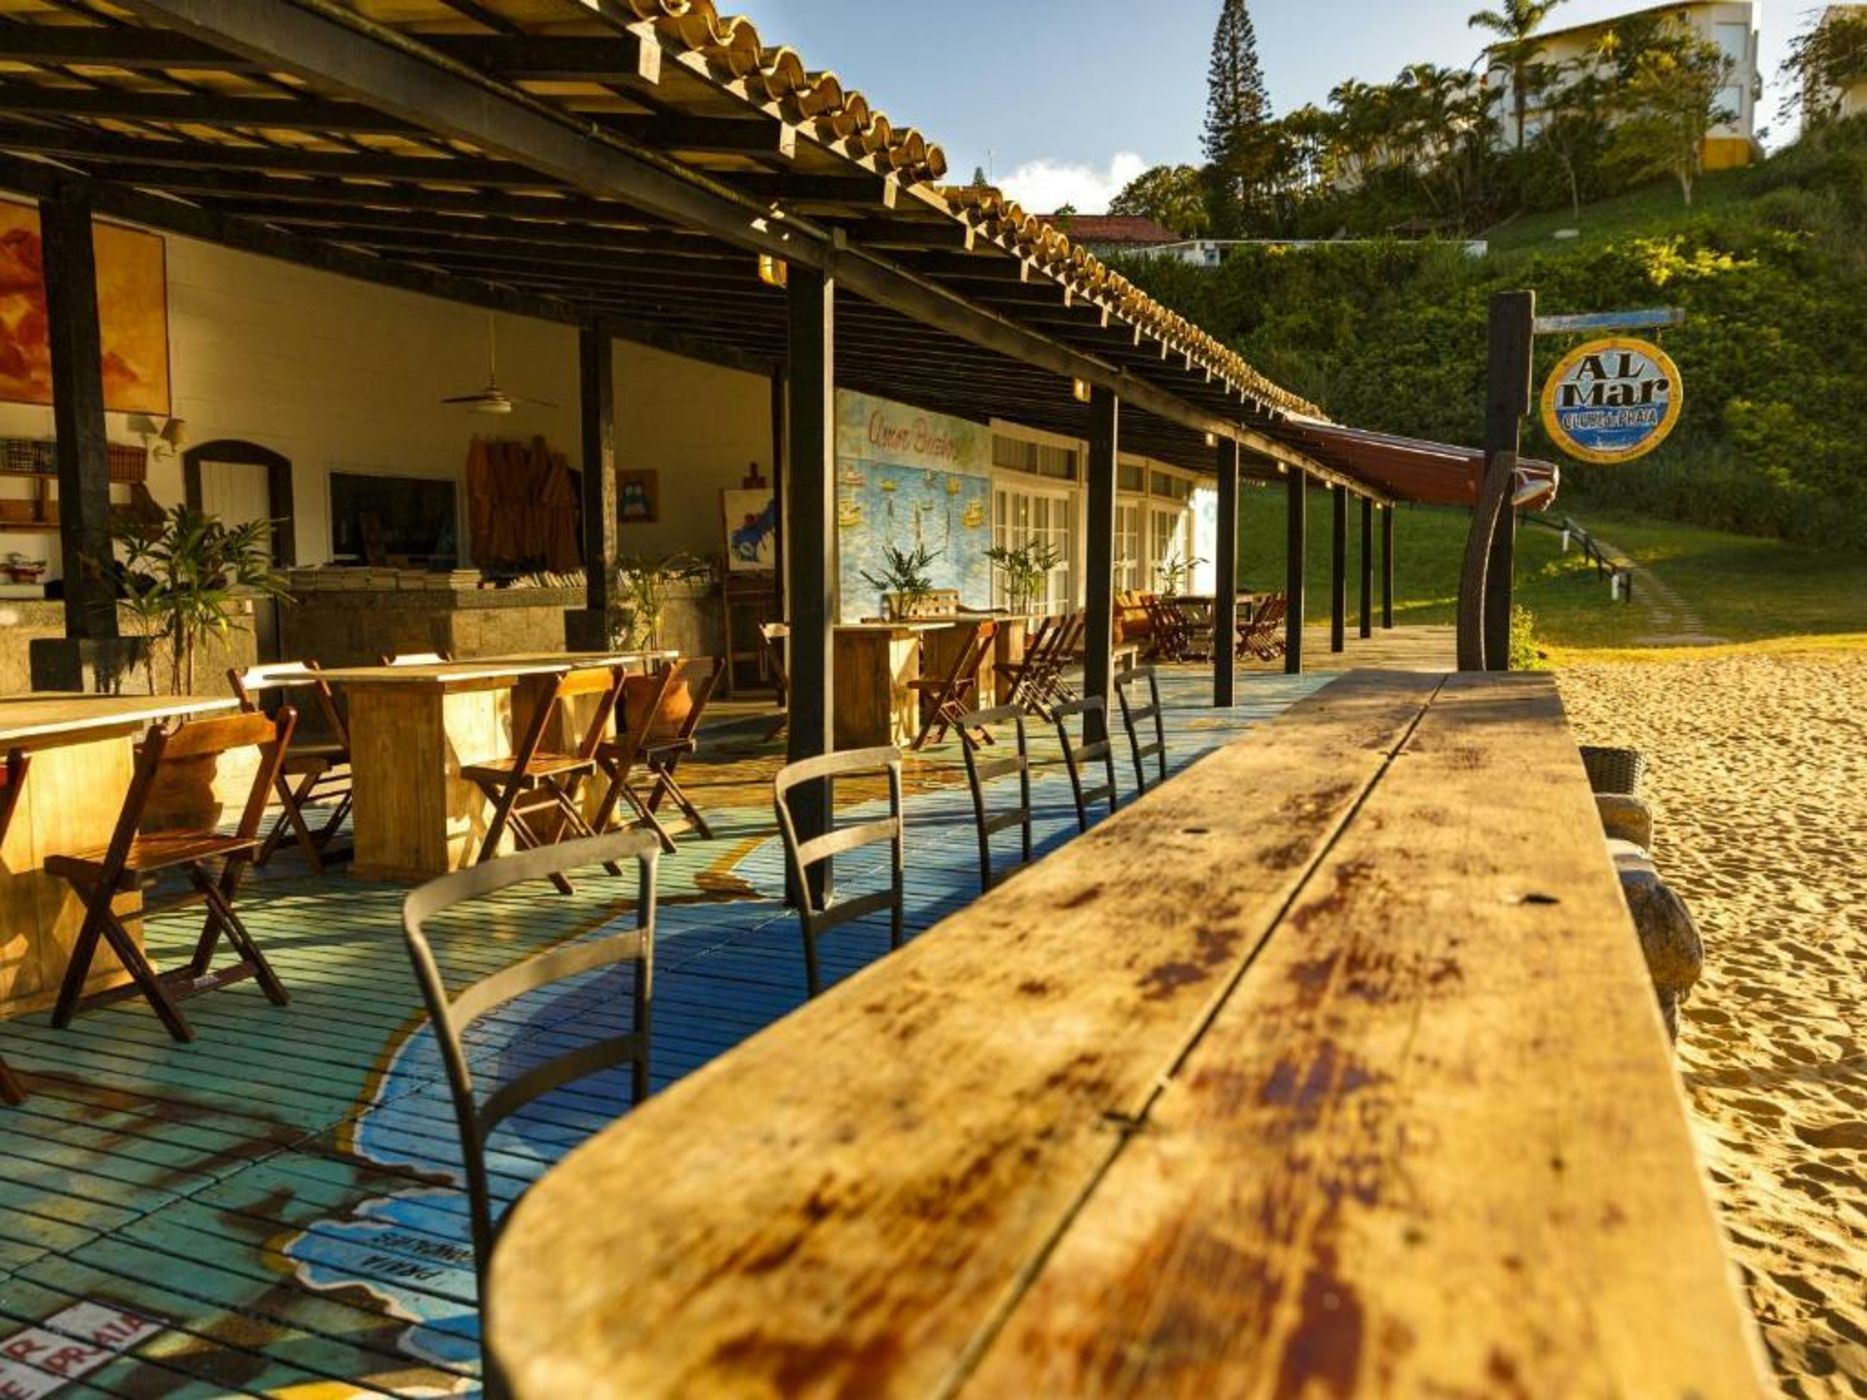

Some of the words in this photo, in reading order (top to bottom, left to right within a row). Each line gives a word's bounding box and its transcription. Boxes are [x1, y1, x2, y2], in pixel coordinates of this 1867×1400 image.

[1572, 353, 1646, 381] AL
[1561, 379, 1669, 408] Mar
[1617, 408, 1658, 428] PRAIA
[45, 1311, 150, 1374] PRAIA
